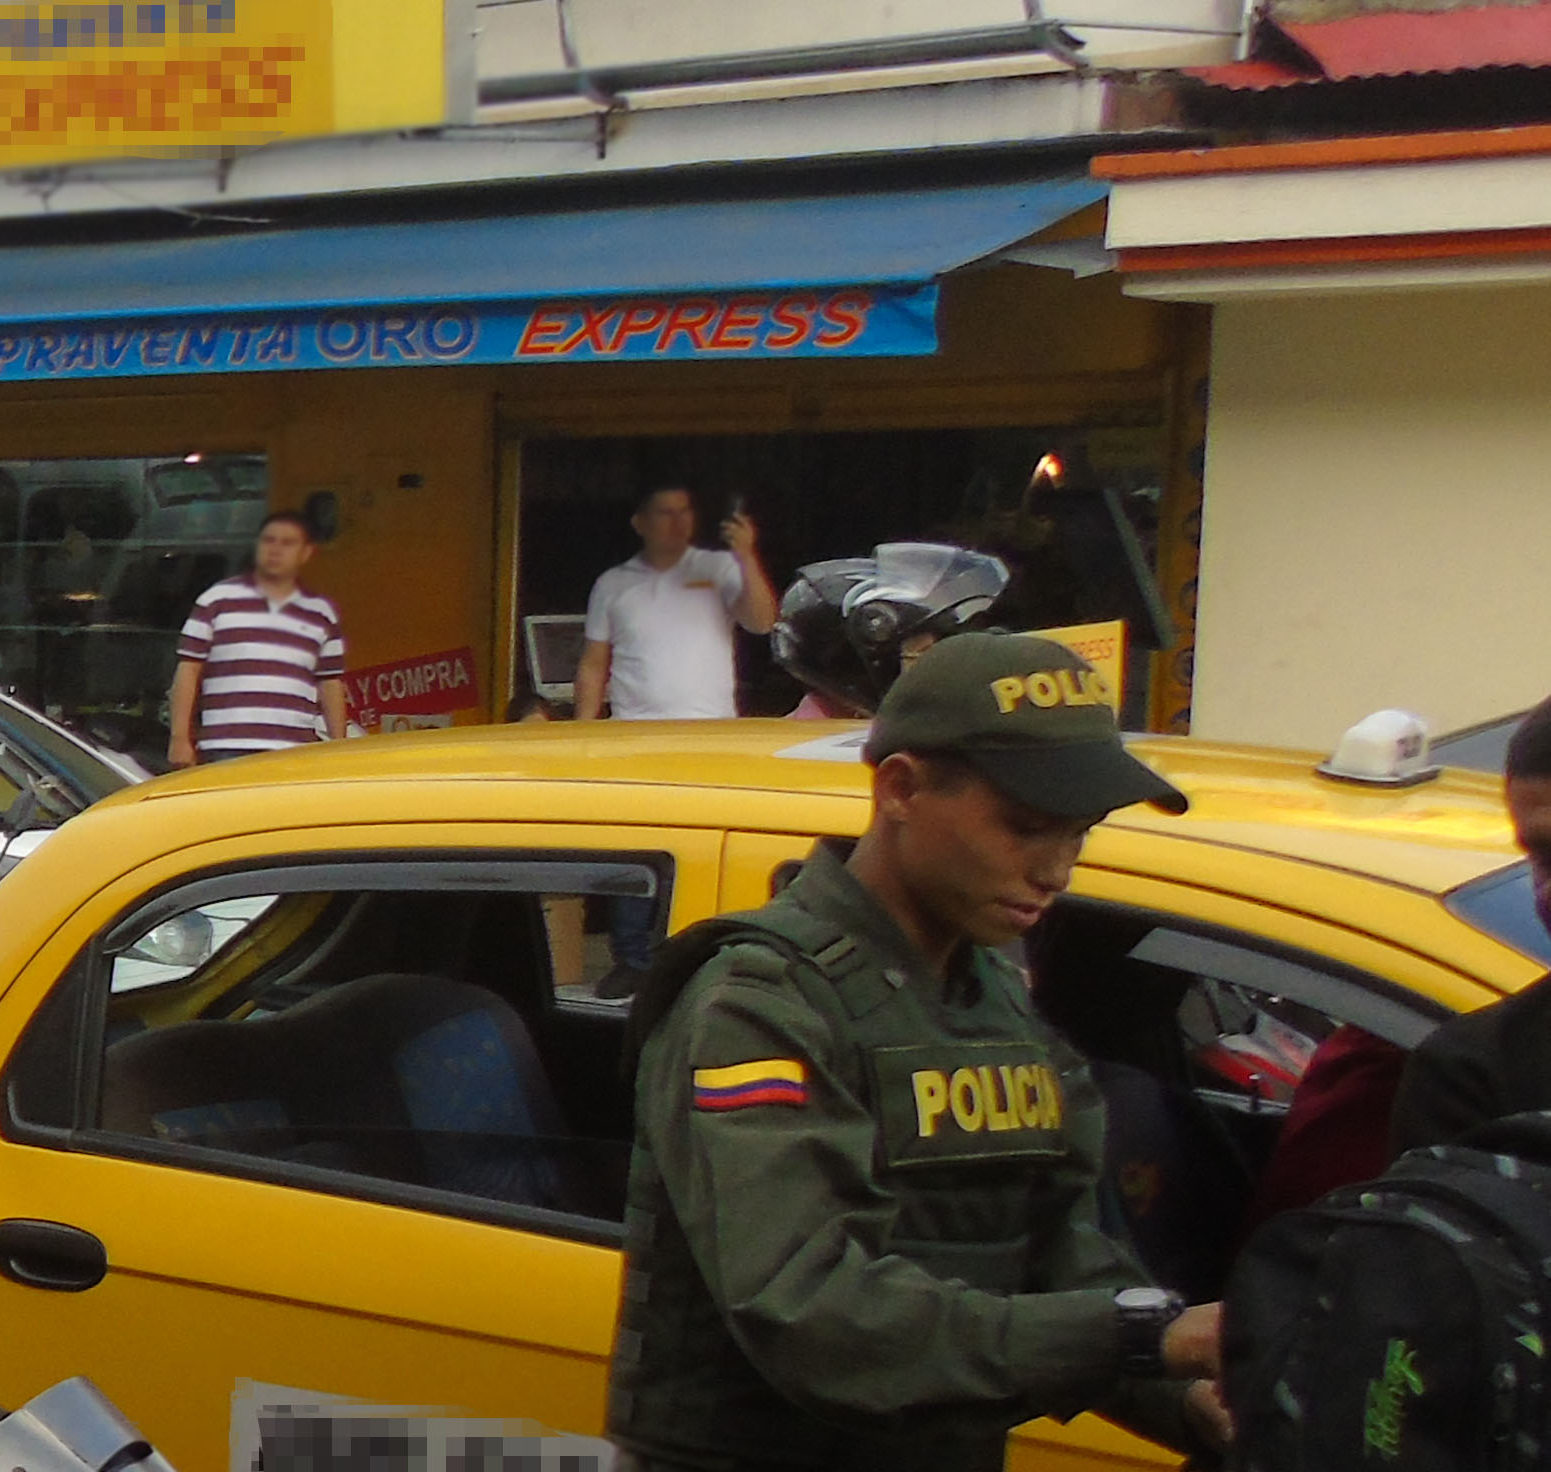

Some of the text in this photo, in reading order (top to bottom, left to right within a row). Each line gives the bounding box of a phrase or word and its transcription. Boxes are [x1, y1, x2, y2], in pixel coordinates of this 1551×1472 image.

[314, 308, 478, 361] ORO
[513, 291, 874, 356] EXPRESS
[356, 676, 371, 705] Y
[376, 658, 470, 702] COMPRA
